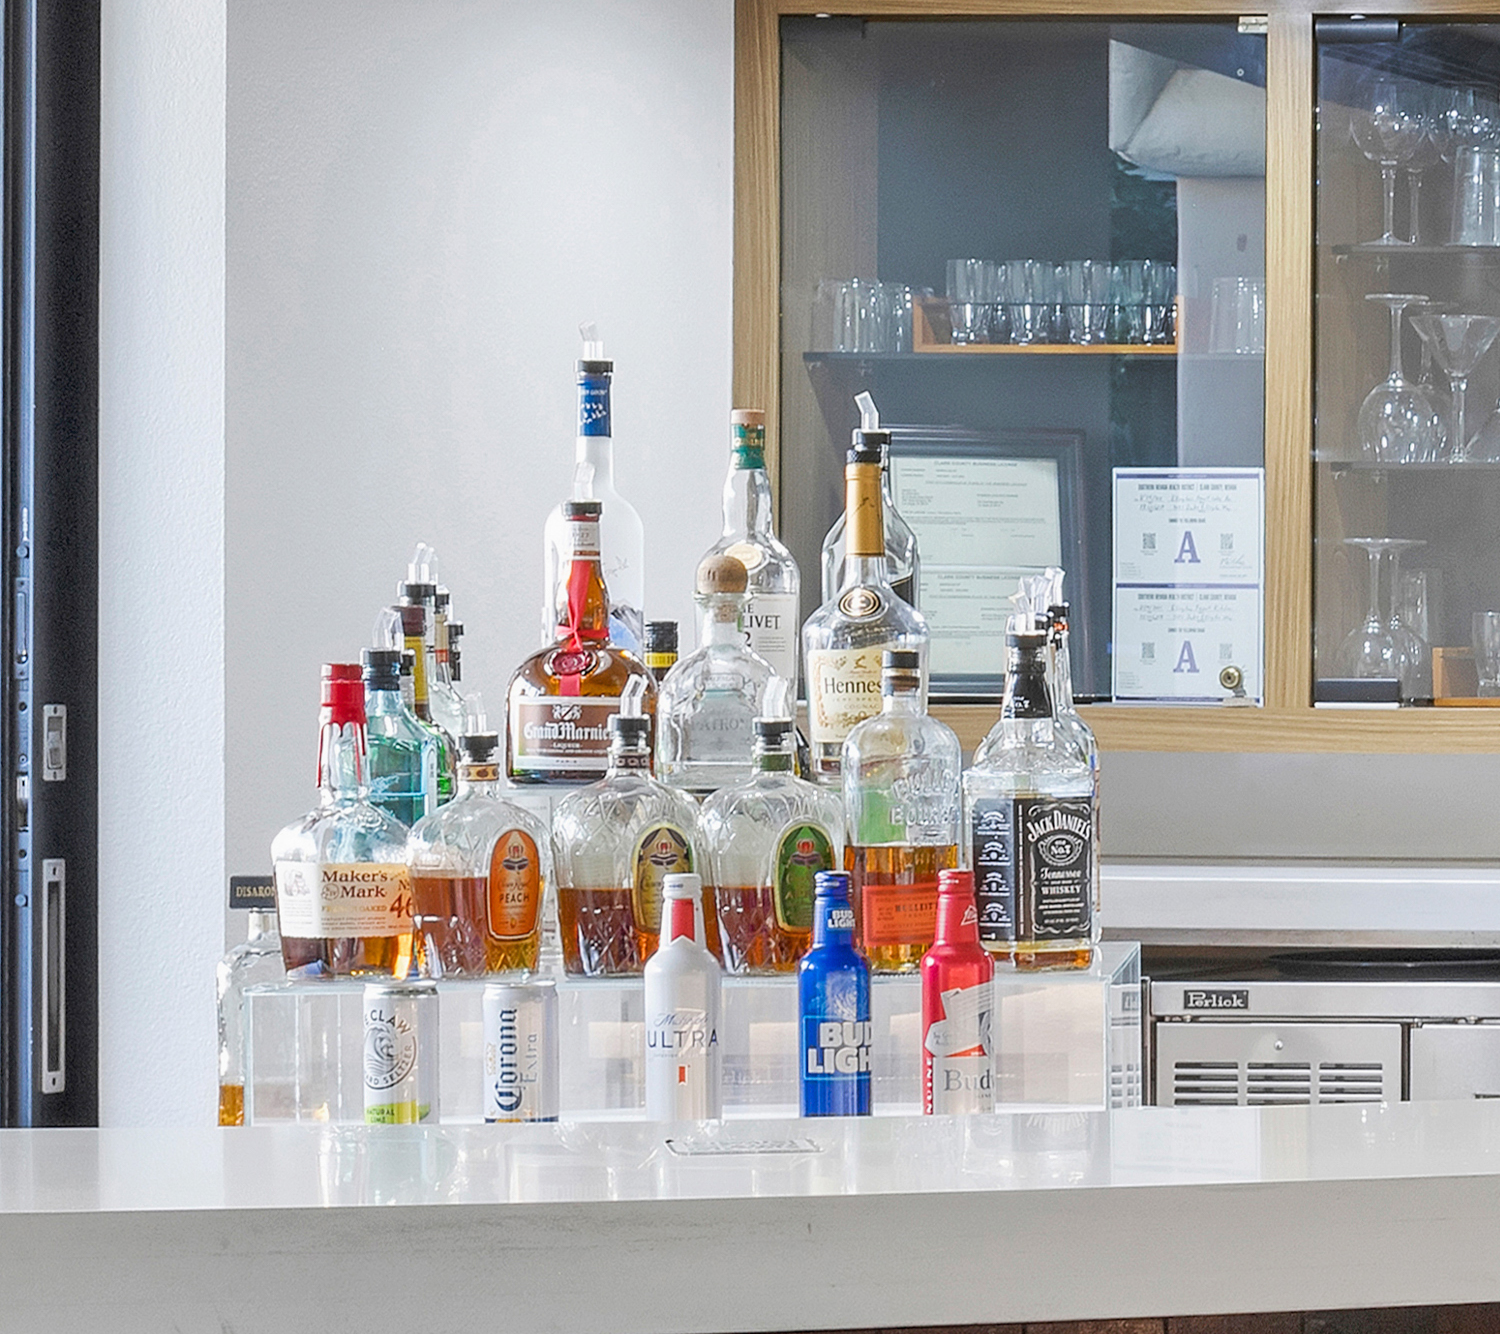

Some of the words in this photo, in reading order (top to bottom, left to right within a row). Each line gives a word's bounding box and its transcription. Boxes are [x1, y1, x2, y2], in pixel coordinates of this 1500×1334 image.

[1174, 531, 1201, 563] A
[1173, 641, 1200, 673] A
[1026, 813, 1056, 842] JACK
[322, 870, 388, 883] Maker's
[340, 885, 386, 899] Mark
[500, 893, 529, 903] PEACH
[1041, 884, 1082, 895] WHISKEY
[832, 910, 854, 919] BUD
[370, 1009, 411, 1035] CLAW
[820, 1020, 872, 1047] BUD
[647, 1029, 719, 1048] ULTRA
[494, 1009, 522, 1112] Corona
[808, 1048, 872, 1074] LIGH
[944, 1069, 991, 1091] Bud
